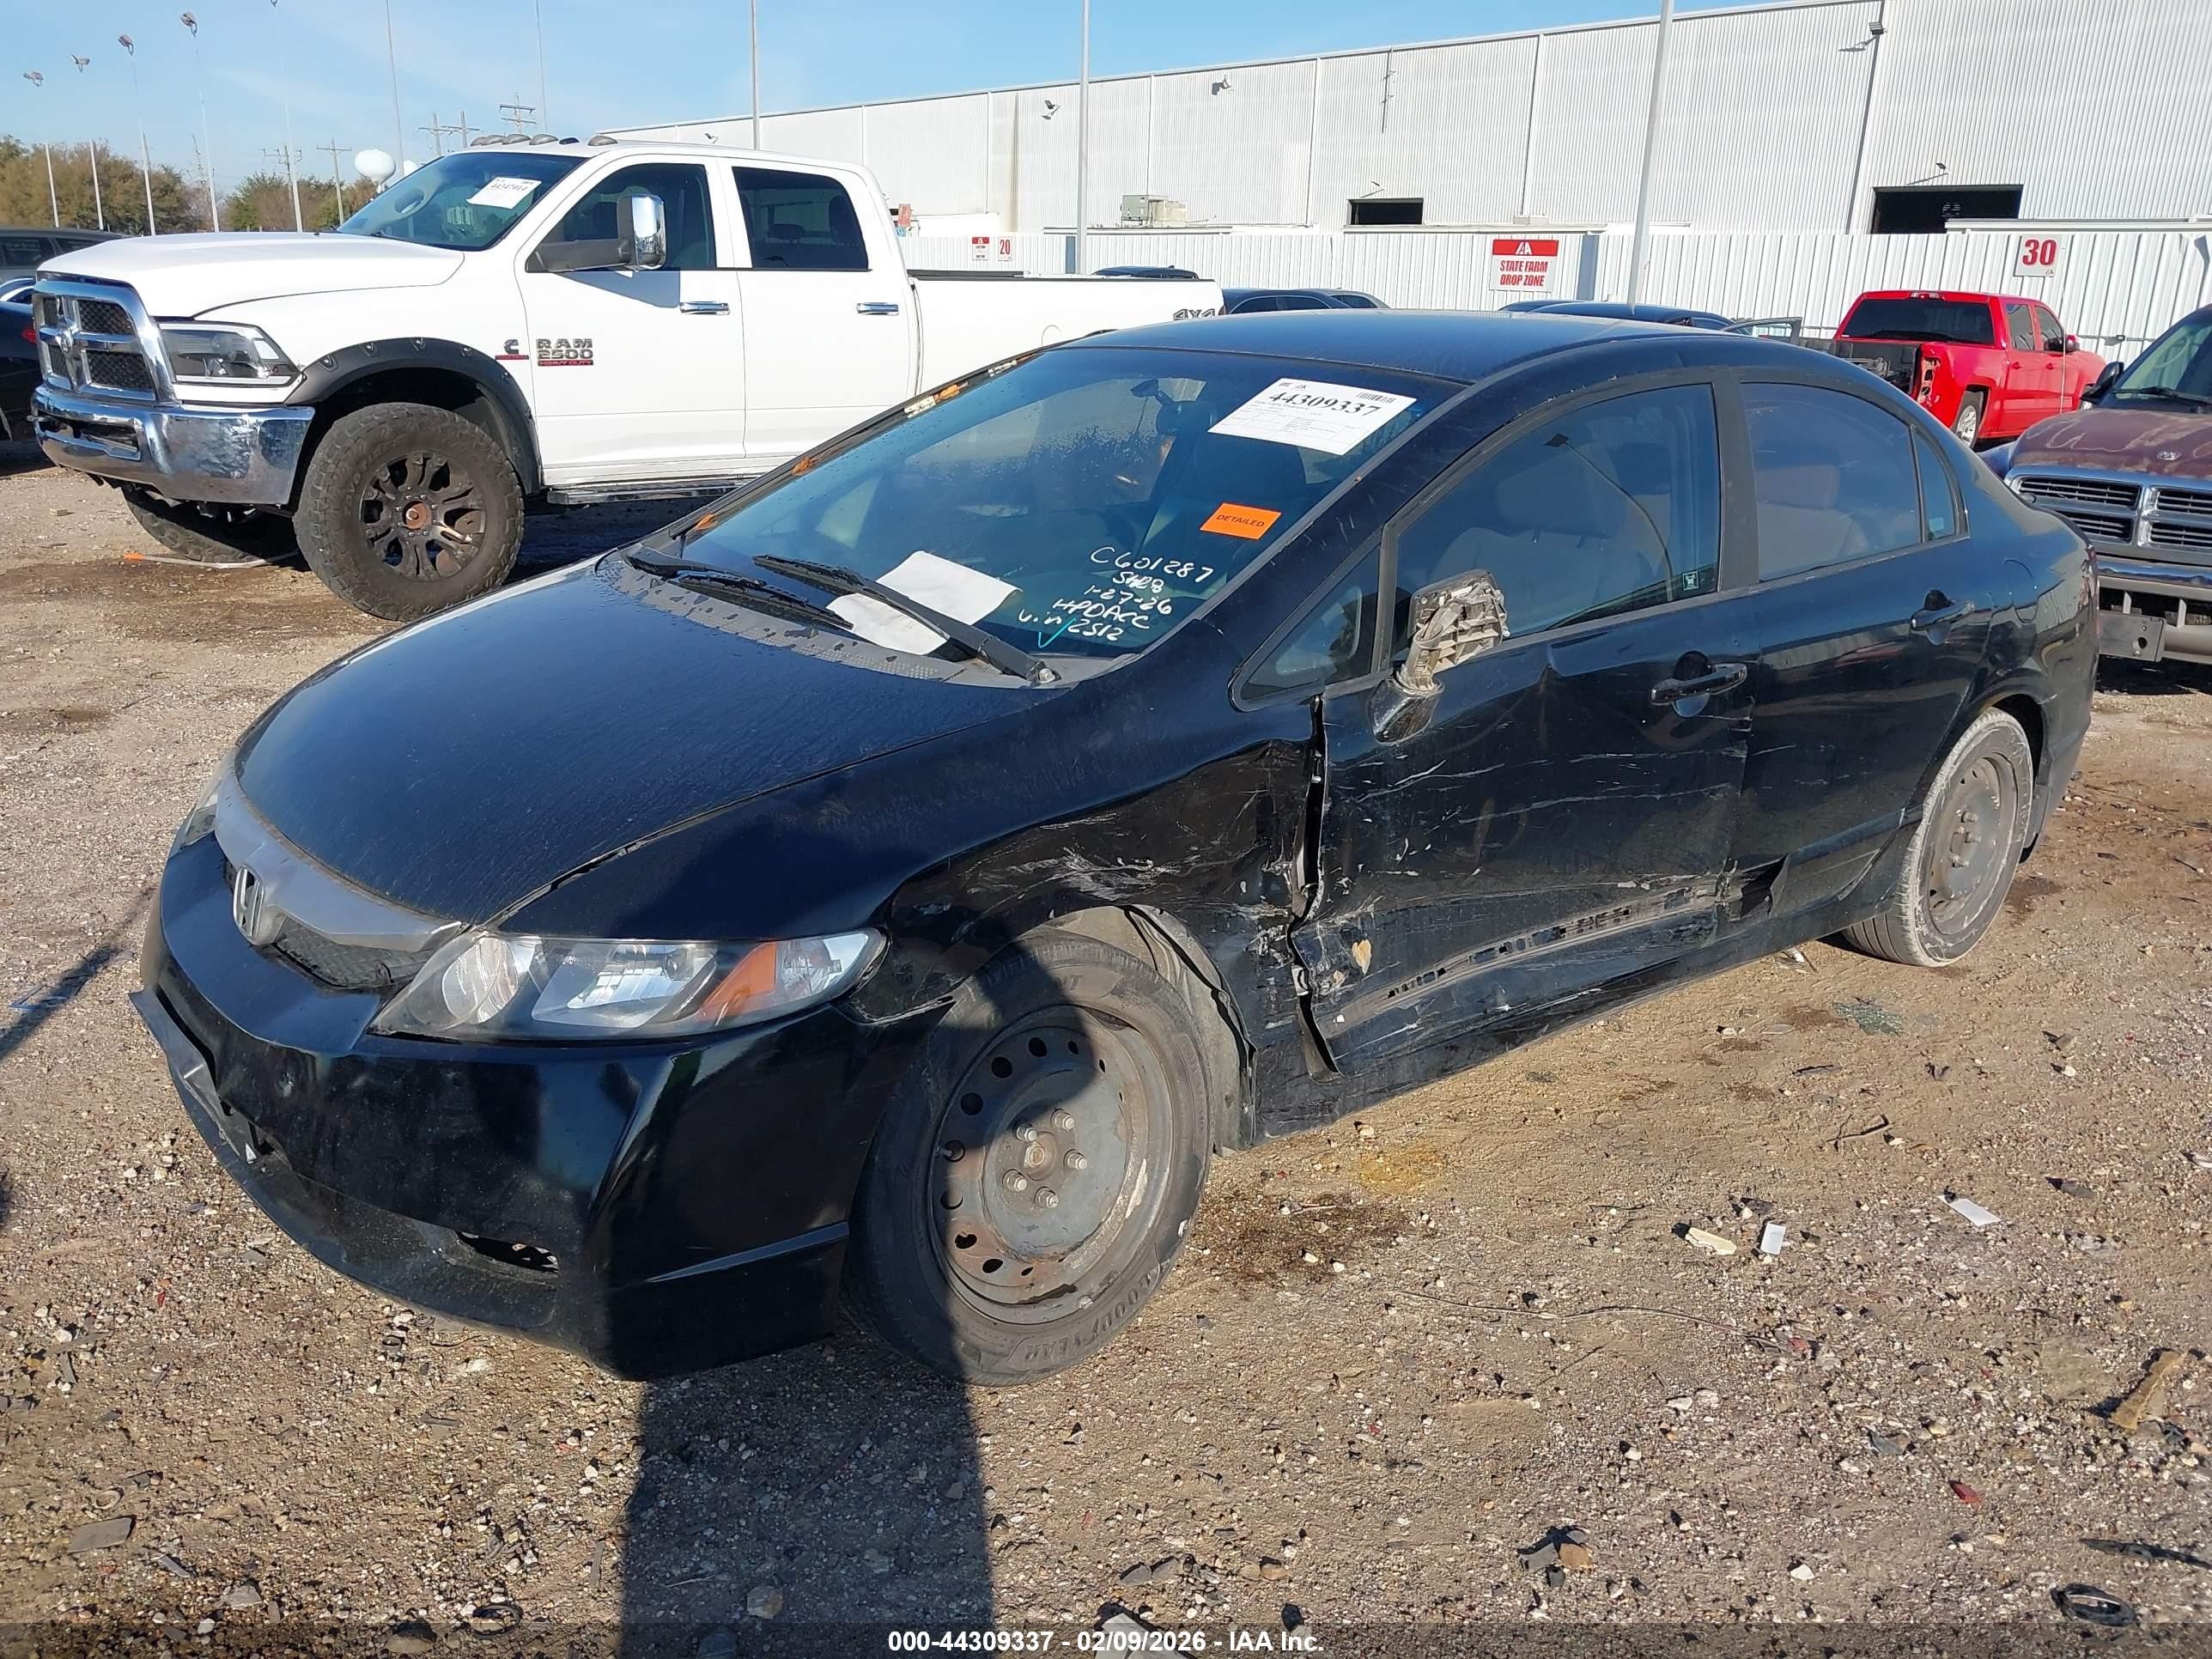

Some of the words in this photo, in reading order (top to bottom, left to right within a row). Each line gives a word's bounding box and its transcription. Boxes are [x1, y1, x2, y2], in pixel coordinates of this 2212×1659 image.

[1000, 239, 1011, 255] 20
[2022, 239, 2057, 266] 30
[1499, 260, 1524, 272] STATE
[1525, 261, 1548, 273] FARM
[1499, 274, 1522, 286] DROP
[1523, 275, 1545, 287] ZONE
[536, 338, 592, 349] RAM
[537, 349, 593, 359] 2500
[1268, 392, 1381, 416] 44309337
[1216, 514, 1265, 527] DETAILED
[1091, 547, 1214, 583] C601287
[1084, 585, 1172, 615] 1-27-26
